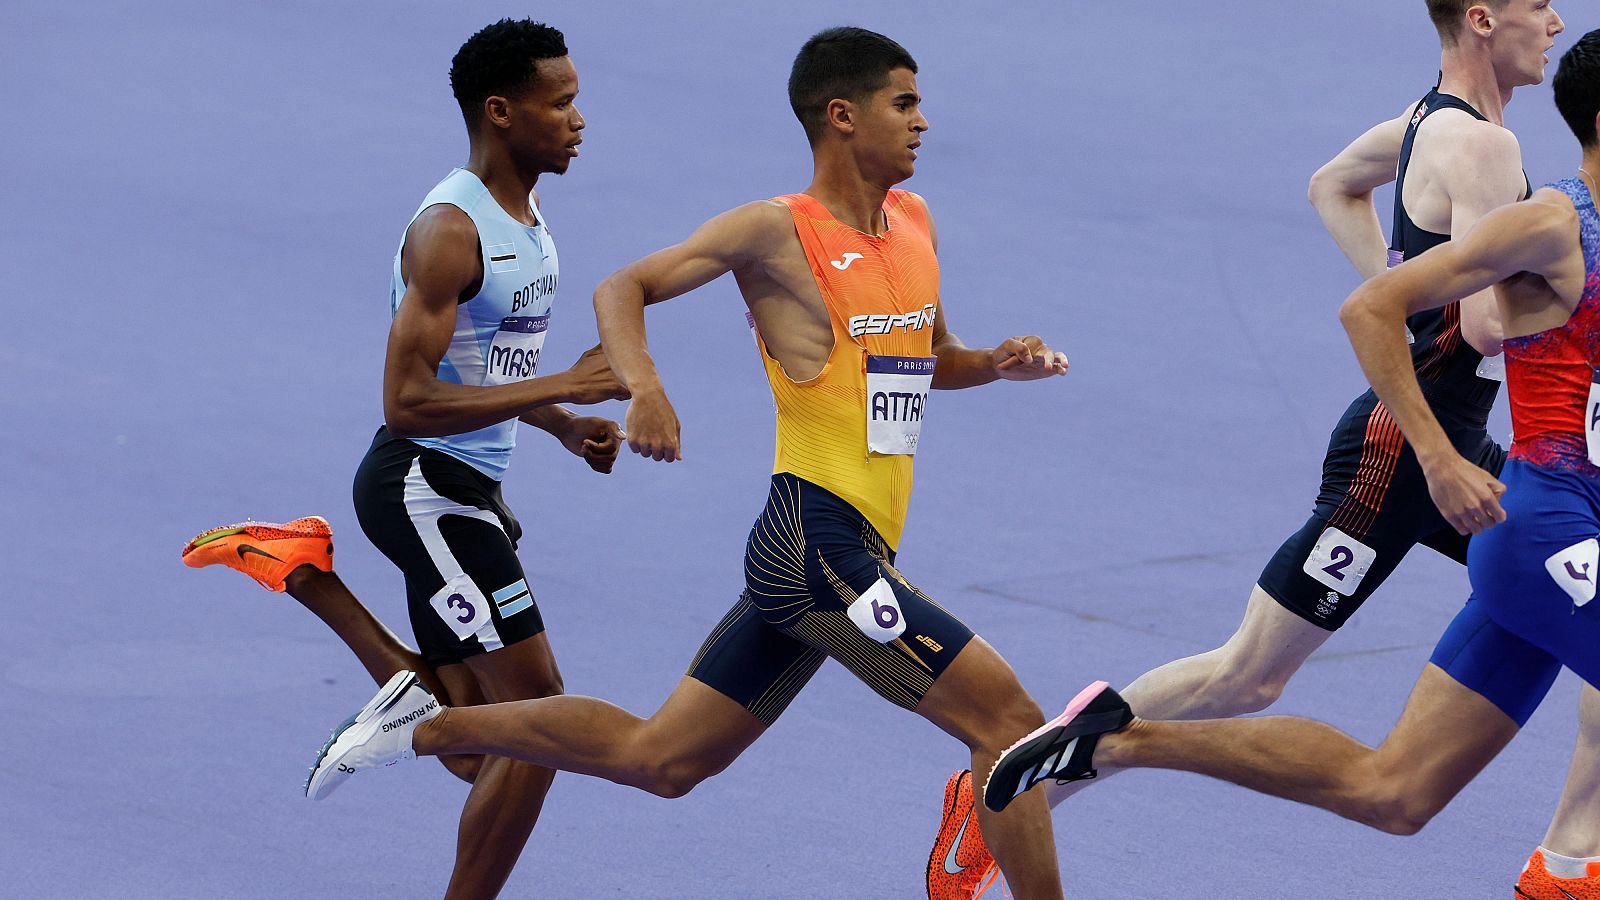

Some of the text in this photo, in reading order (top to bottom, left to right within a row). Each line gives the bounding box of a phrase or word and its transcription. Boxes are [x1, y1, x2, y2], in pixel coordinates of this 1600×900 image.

[1321, 545, 1354, 582] 2
[446, 593, 476, 624] 3
[870, 598, 899, 629] 6
[382, 710, 426, 733] RUNNING
